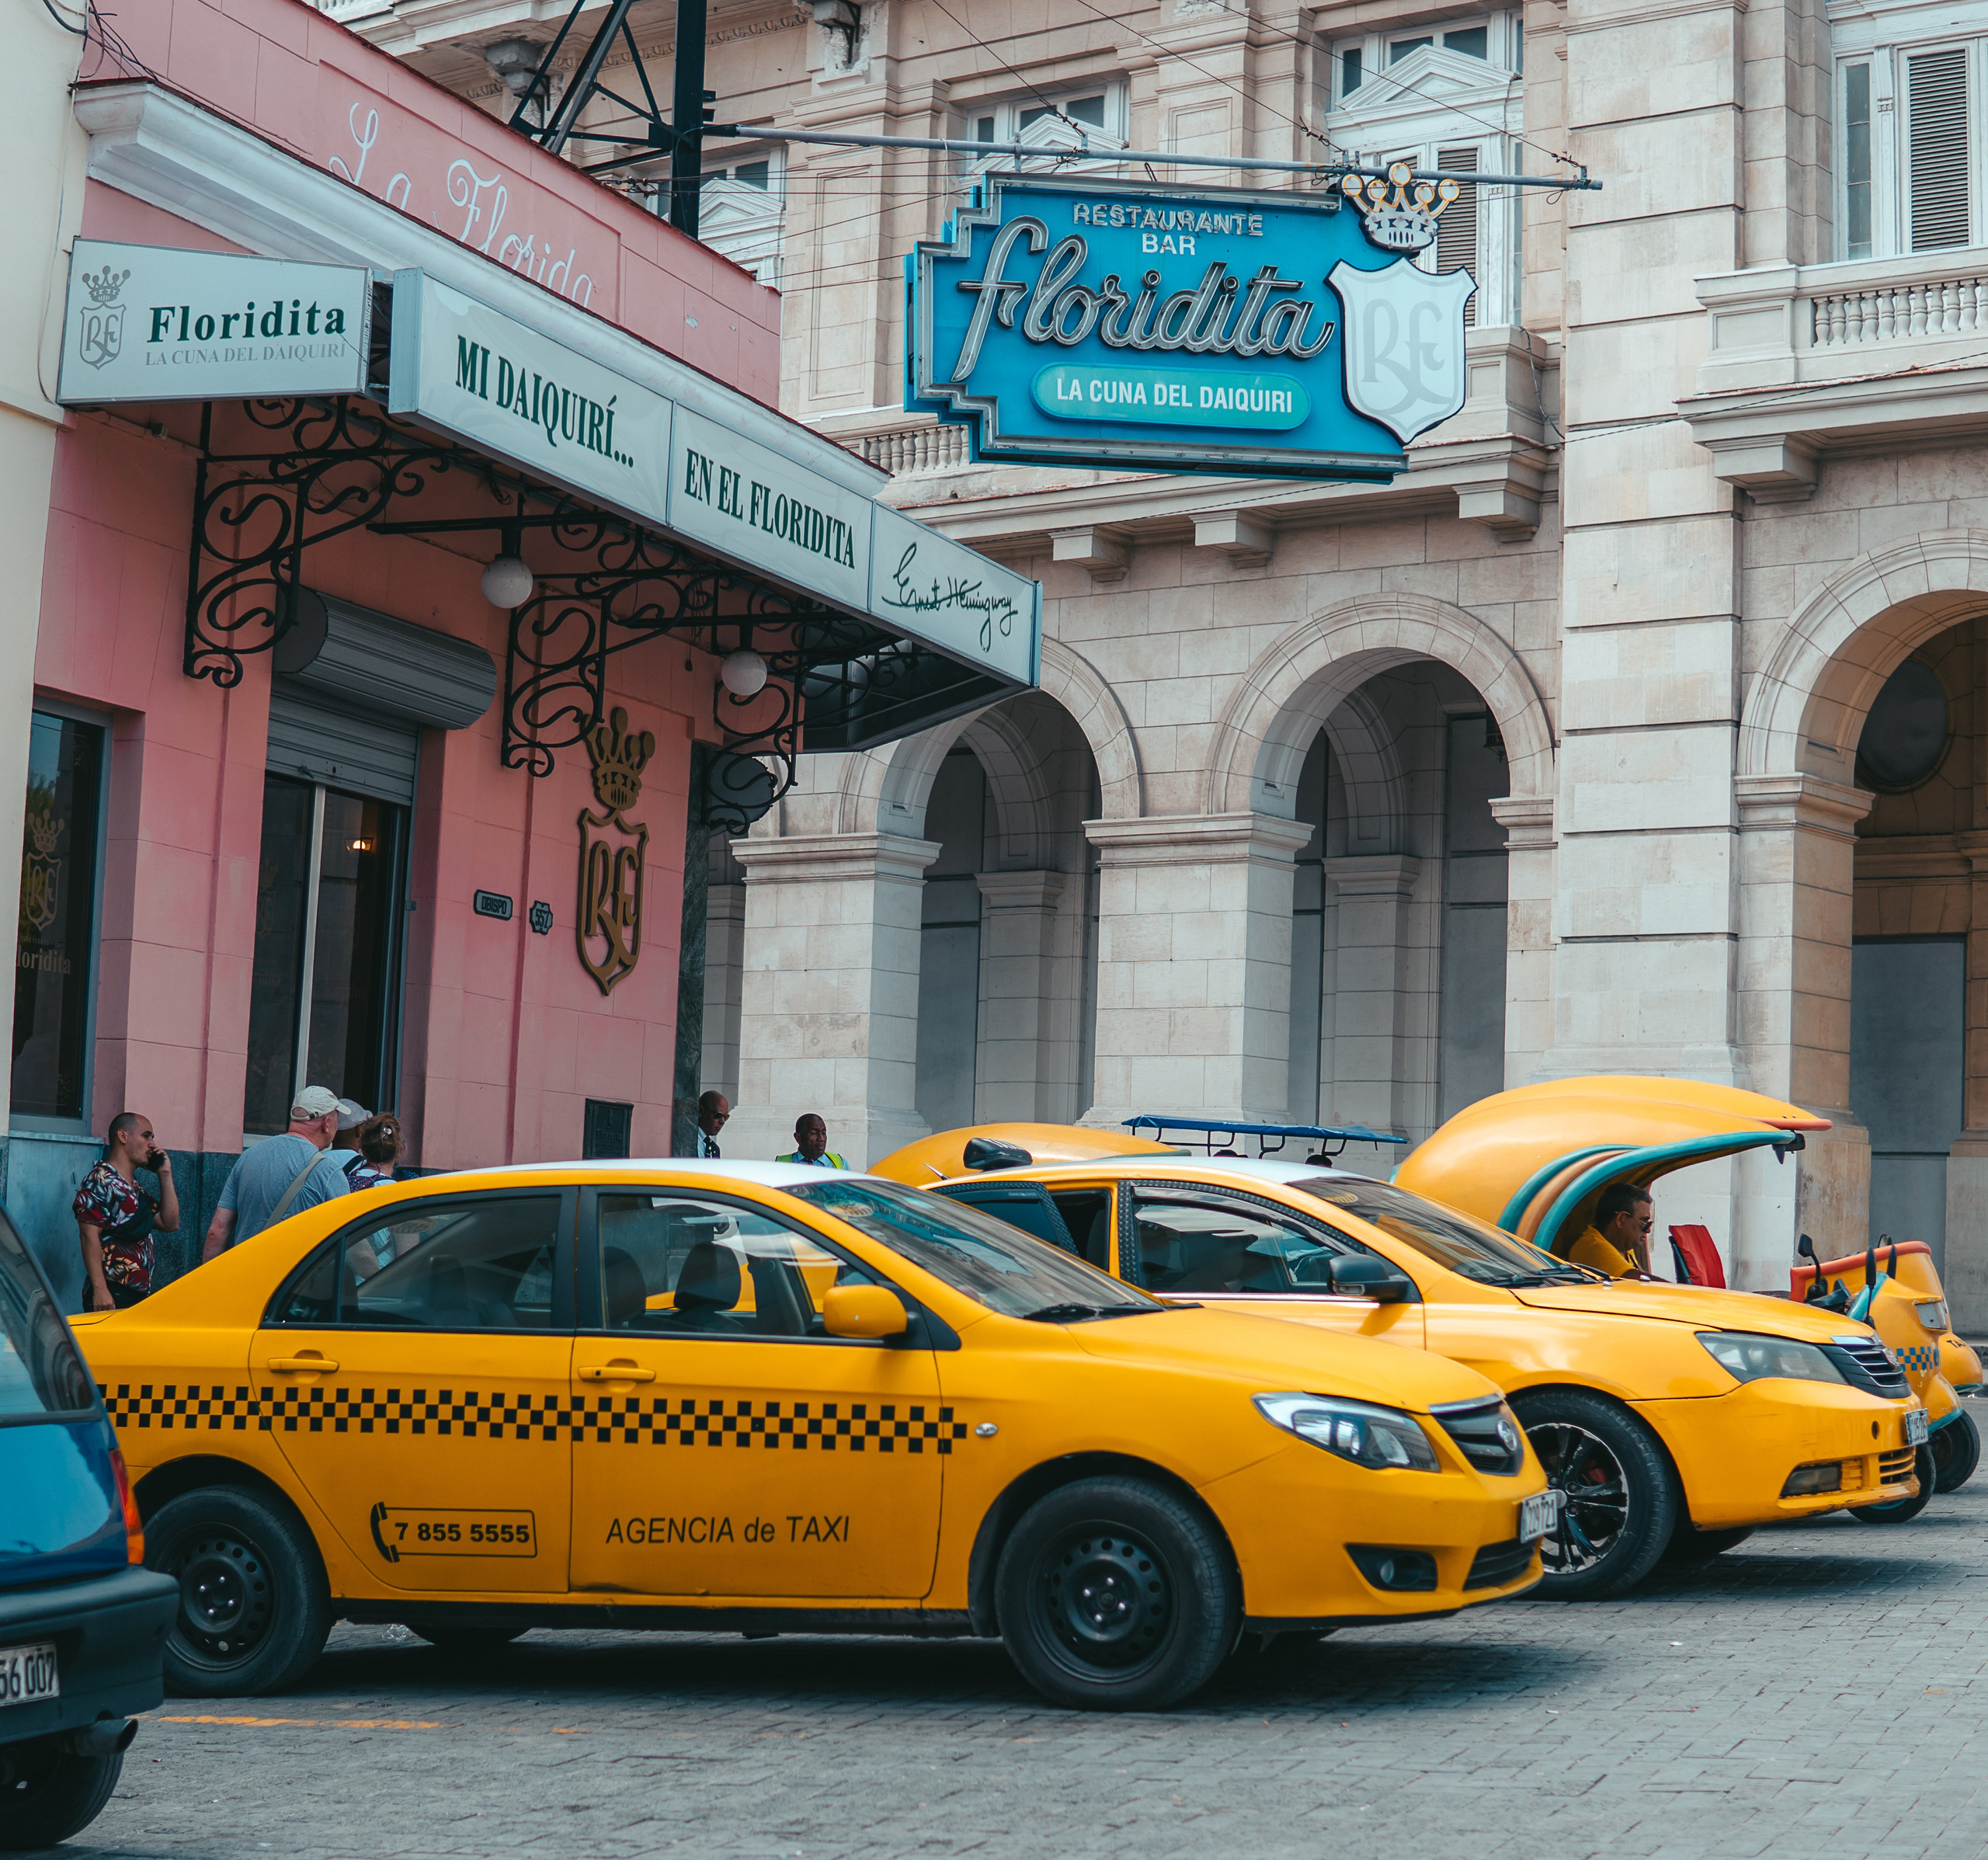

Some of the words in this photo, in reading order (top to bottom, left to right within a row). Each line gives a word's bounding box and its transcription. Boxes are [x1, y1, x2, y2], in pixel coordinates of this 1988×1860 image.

[1073, 203, 1263, 236] RESTAURANTE
[1142, 233, 1196, 256] BAR
[146, 299, 346, 343] Floridita
[145, 351, 167, 366] LA
[172, 349, 219, 365] CUNA
[224, 346, 258, 362] DEL
[455, 334, 490, 401] MI
[495, 355, 634, 468] DAIQUIRÍ...
[1057, 378, 1083, 402] LA
[1090, 380, 1147, 405] CUNA
[1154, 384, 1193, 407] DEL
[1200, 386, 1292, 413] DAIQUIRI
[684, 447, 714, 506] EN
[718, 464, 743, 521] EL
[749, 480, 855, 569] FLORIDITA
[481, 895, 507, 915] OBISPO
[535, 908, 550, 928] 557
[17, 945, 71, 975] loridita
[394, 1522, 408, 1540] 7
[418, 1523, 461, 1542] 855
[470, 1524, 530, 1543] 5555
[606, 1517, 734, 1544] AGENCIA
[744, 1516, 775, 1542] de
[786, 1515, 850, 1542] TAXI
